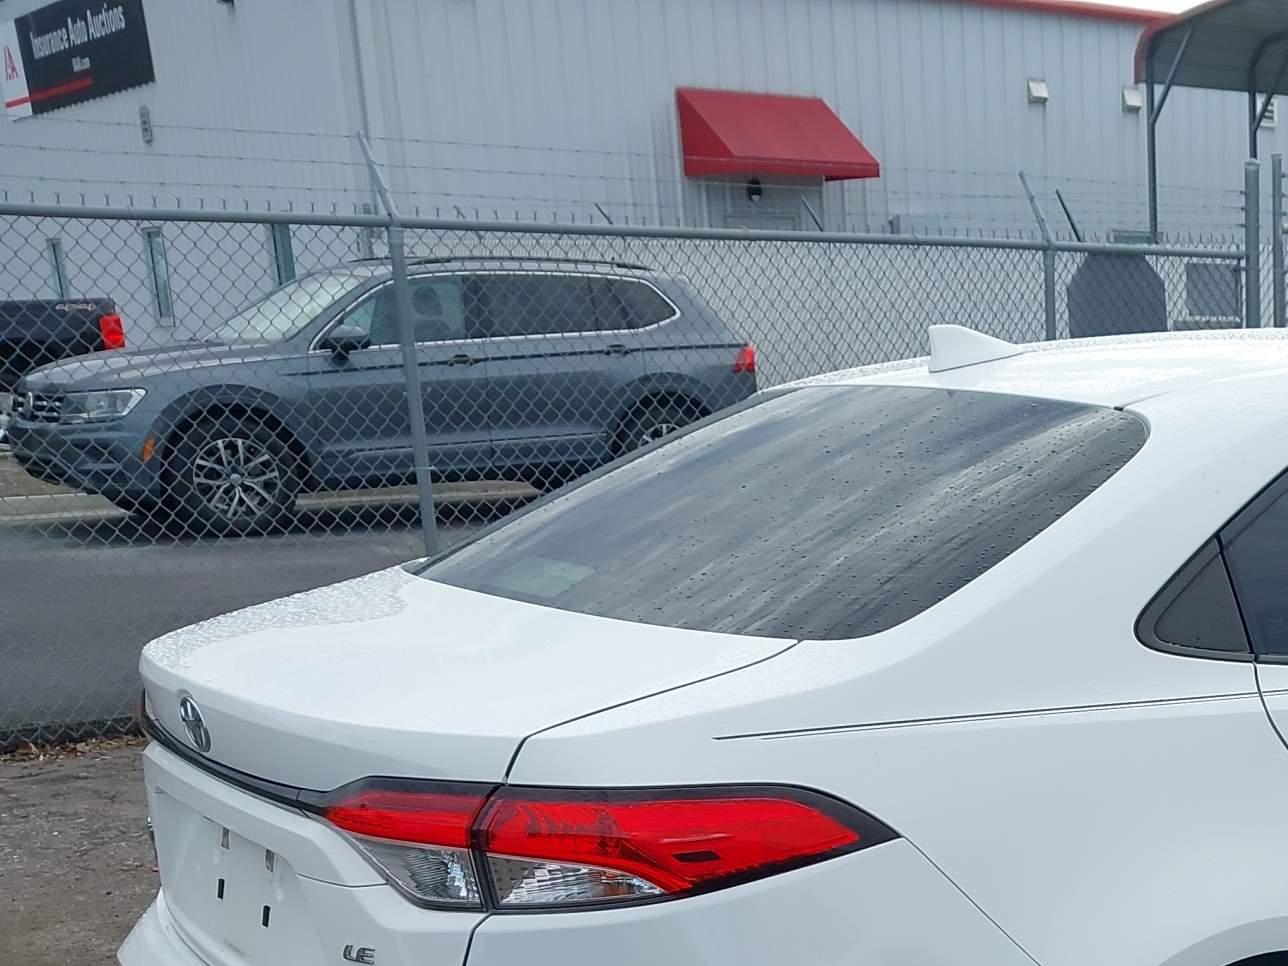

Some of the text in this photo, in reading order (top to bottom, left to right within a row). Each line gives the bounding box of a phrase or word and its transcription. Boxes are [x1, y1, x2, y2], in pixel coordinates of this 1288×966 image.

[30, 2, 126, 60] Insurance Auto Auctions
[343, 944, 376, 965] LE
